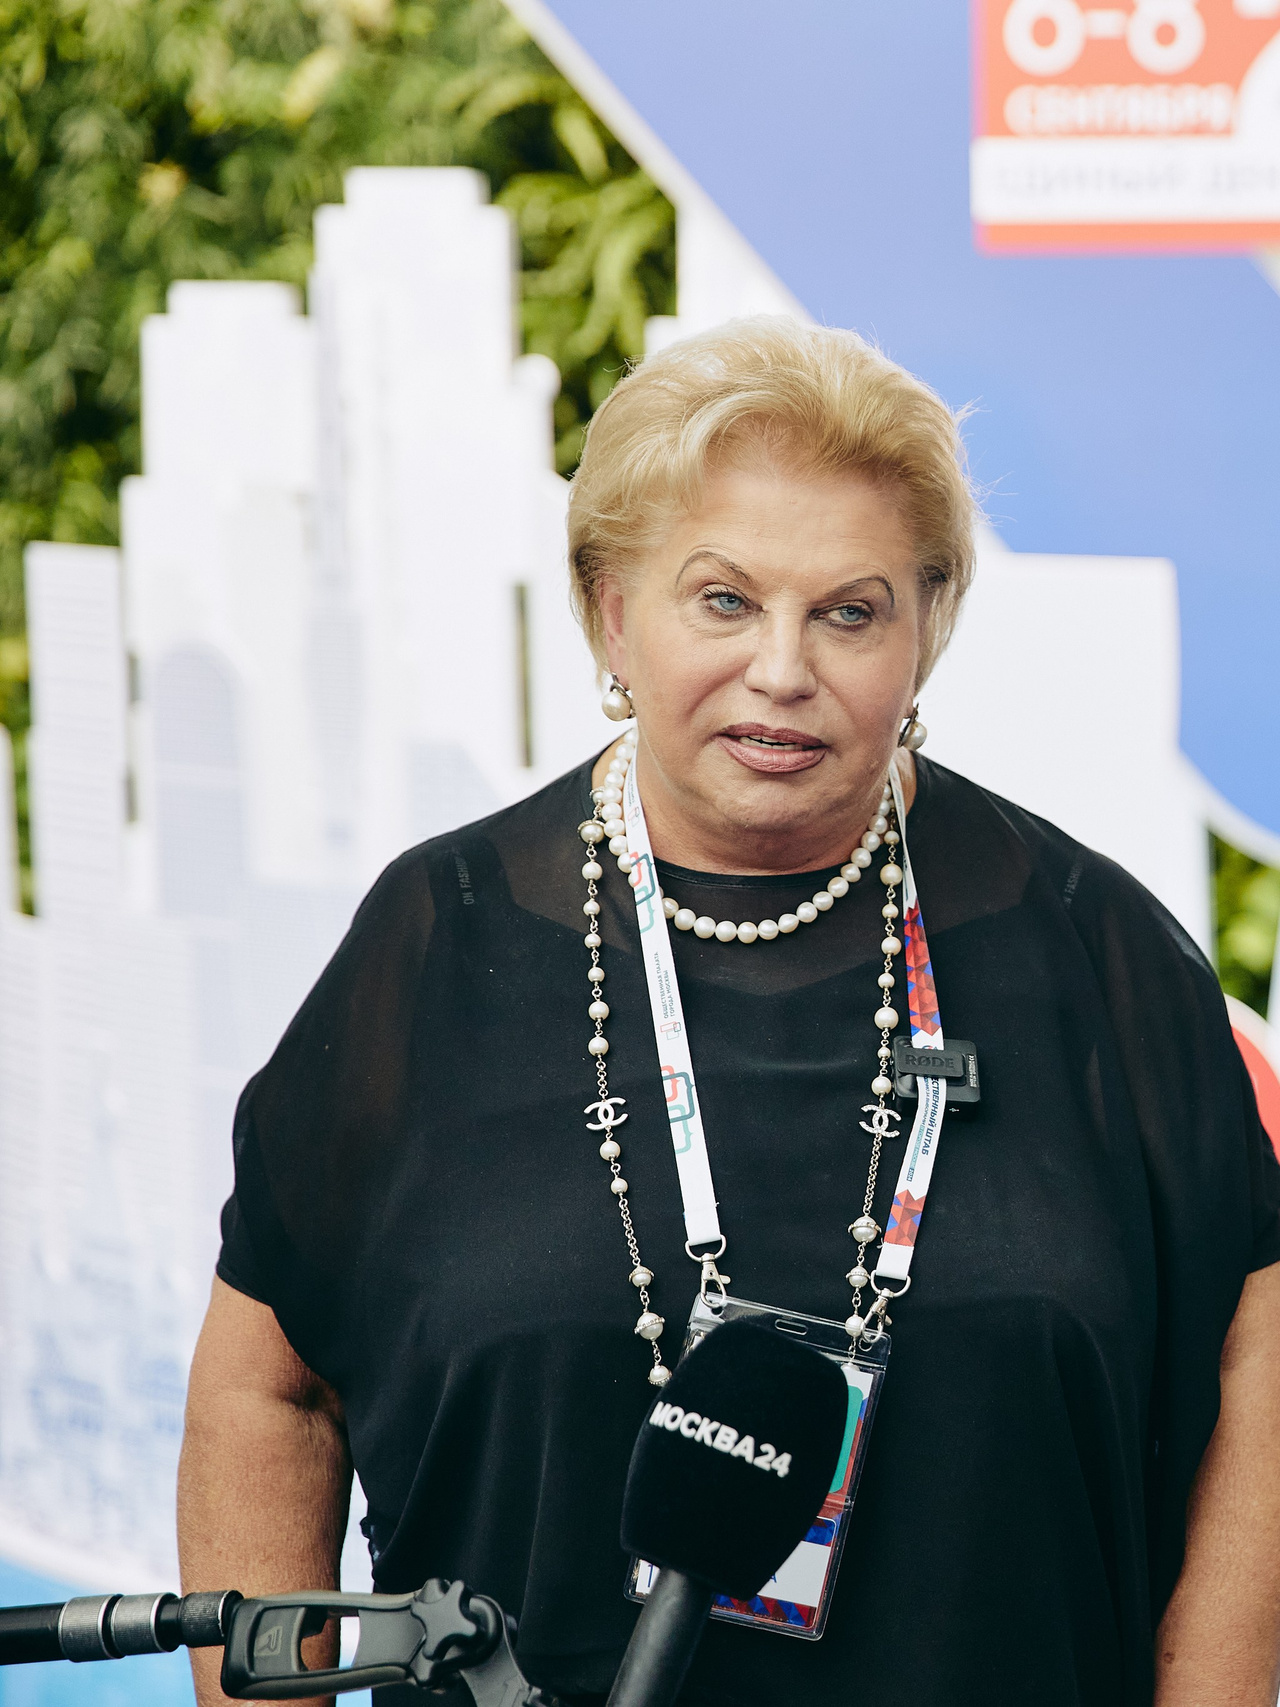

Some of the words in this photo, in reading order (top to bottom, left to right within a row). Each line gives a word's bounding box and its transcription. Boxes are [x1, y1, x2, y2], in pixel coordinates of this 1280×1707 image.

[905, 1054, 955, 1069] RØDE
[928, 1077, 940, 1128] ЕСТВЕННЫЙ
[921, 1129, 934, 1156] ШТАБ
